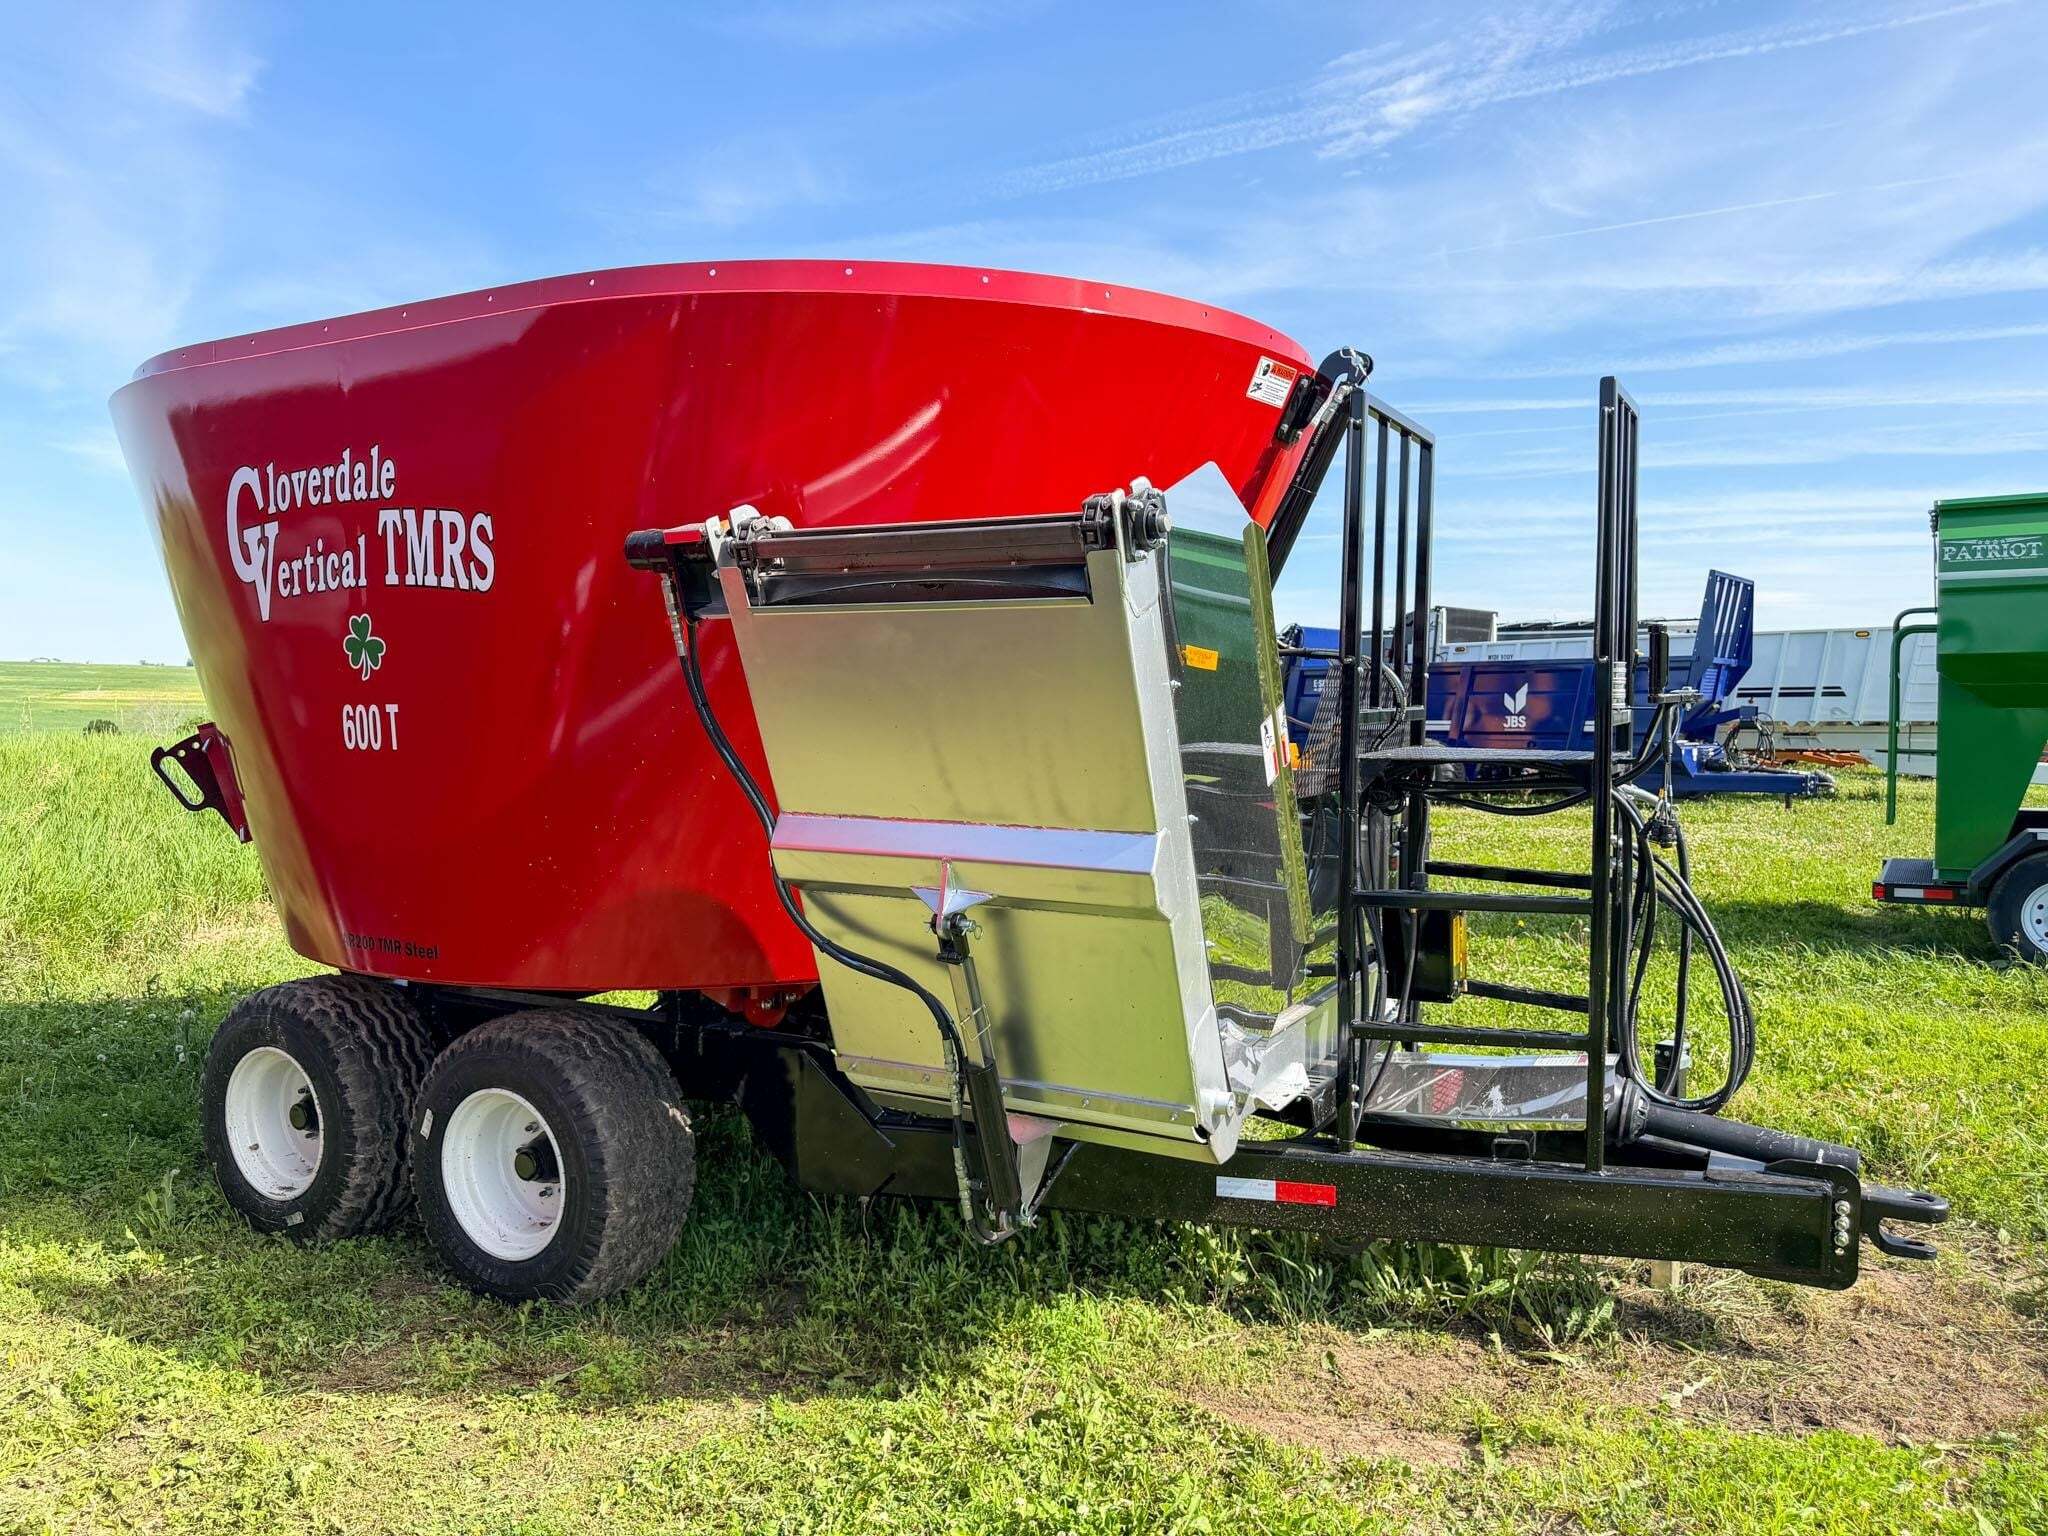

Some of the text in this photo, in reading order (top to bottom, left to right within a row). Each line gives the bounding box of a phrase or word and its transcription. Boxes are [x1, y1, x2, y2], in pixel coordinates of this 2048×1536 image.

[227, 444, 396, 584] Cloverdale
[242, 508, 495, 622] Vertical TMRS
[1942, 542, 2043, 560] PATRIOT
[342, 703, 399, 751] 600 T
[1503, 715, 1527, 728] JBS
[344, 933, 439, 959] R200 TMR Steel
